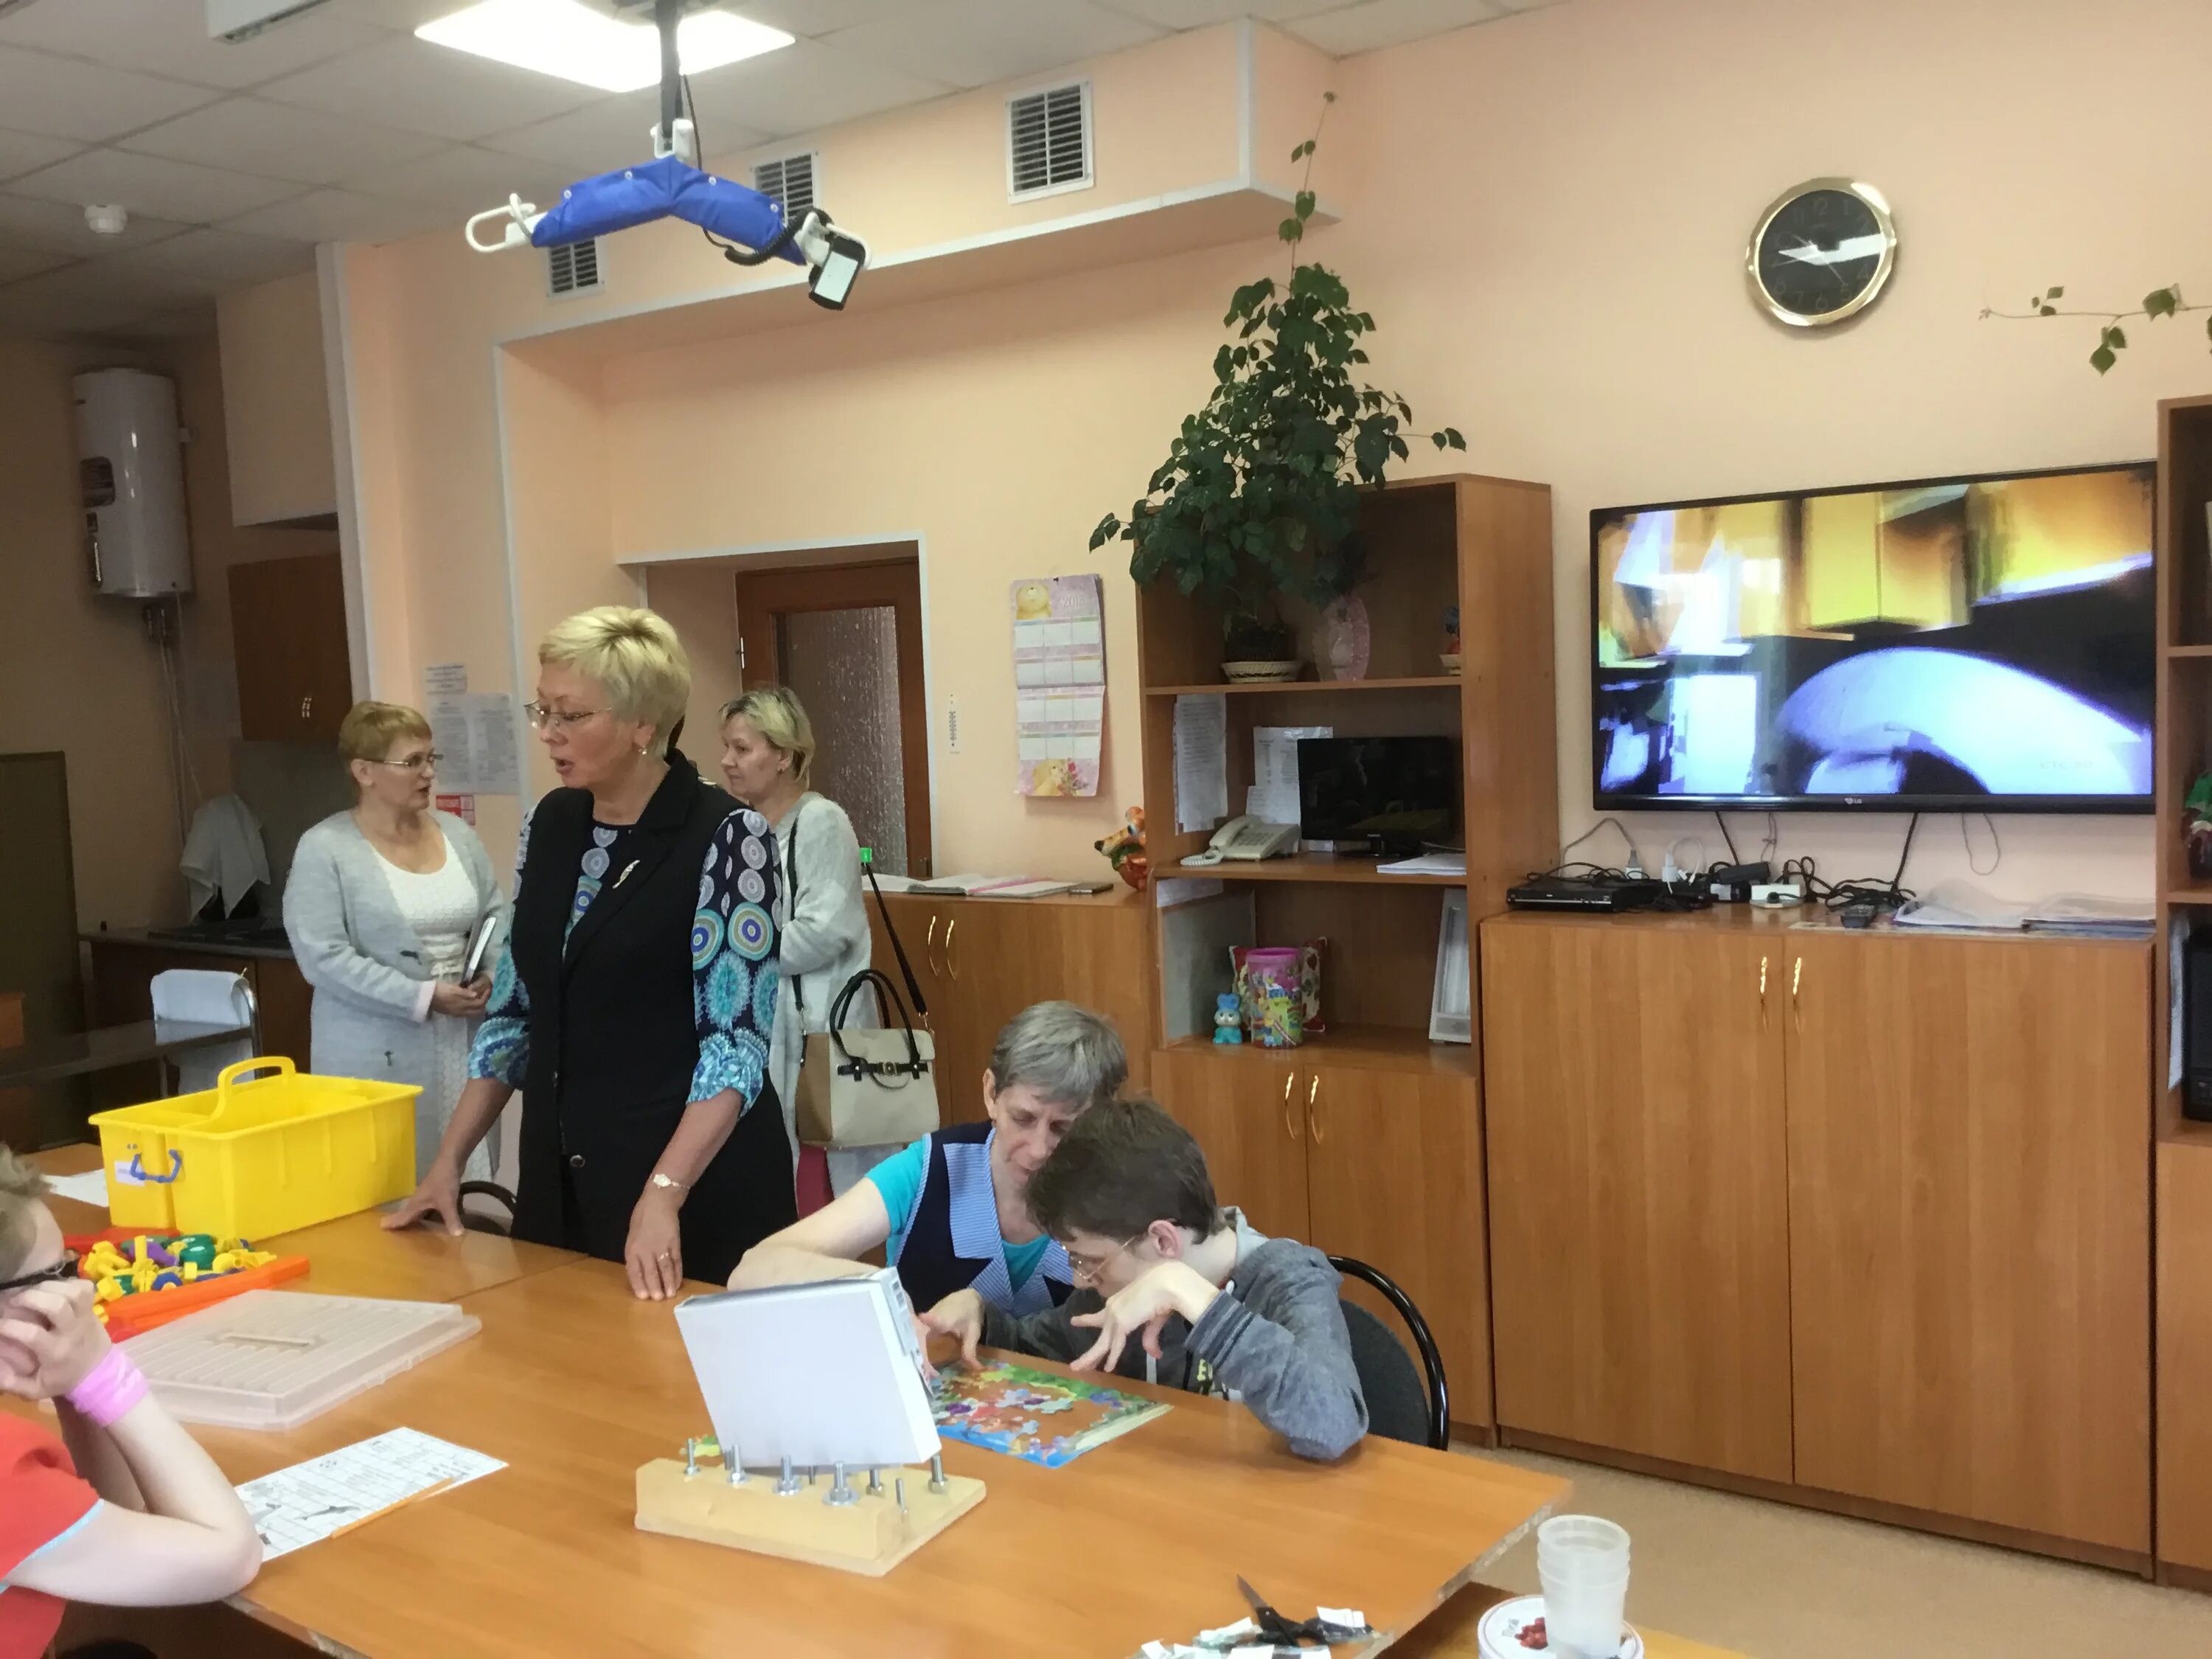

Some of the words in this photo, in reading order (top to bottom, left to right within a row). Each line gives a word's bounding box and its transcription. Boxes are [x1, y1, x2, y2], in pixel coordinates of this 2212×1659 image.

[1792, 206, 1804, 224] 11
[1813, 197, 1829, 216] 12
[1842, 199, 1849, 216] 1
[1857, 214, 1871, 232] 2
[1857, 263, 1869, 279] 4
[1775, 275, 1787, 294] 8
[1795, 289, 1804, 305] 7
[1815, 289, 1829, 310] 6
[1063, 595, 1085, 608] 2018
